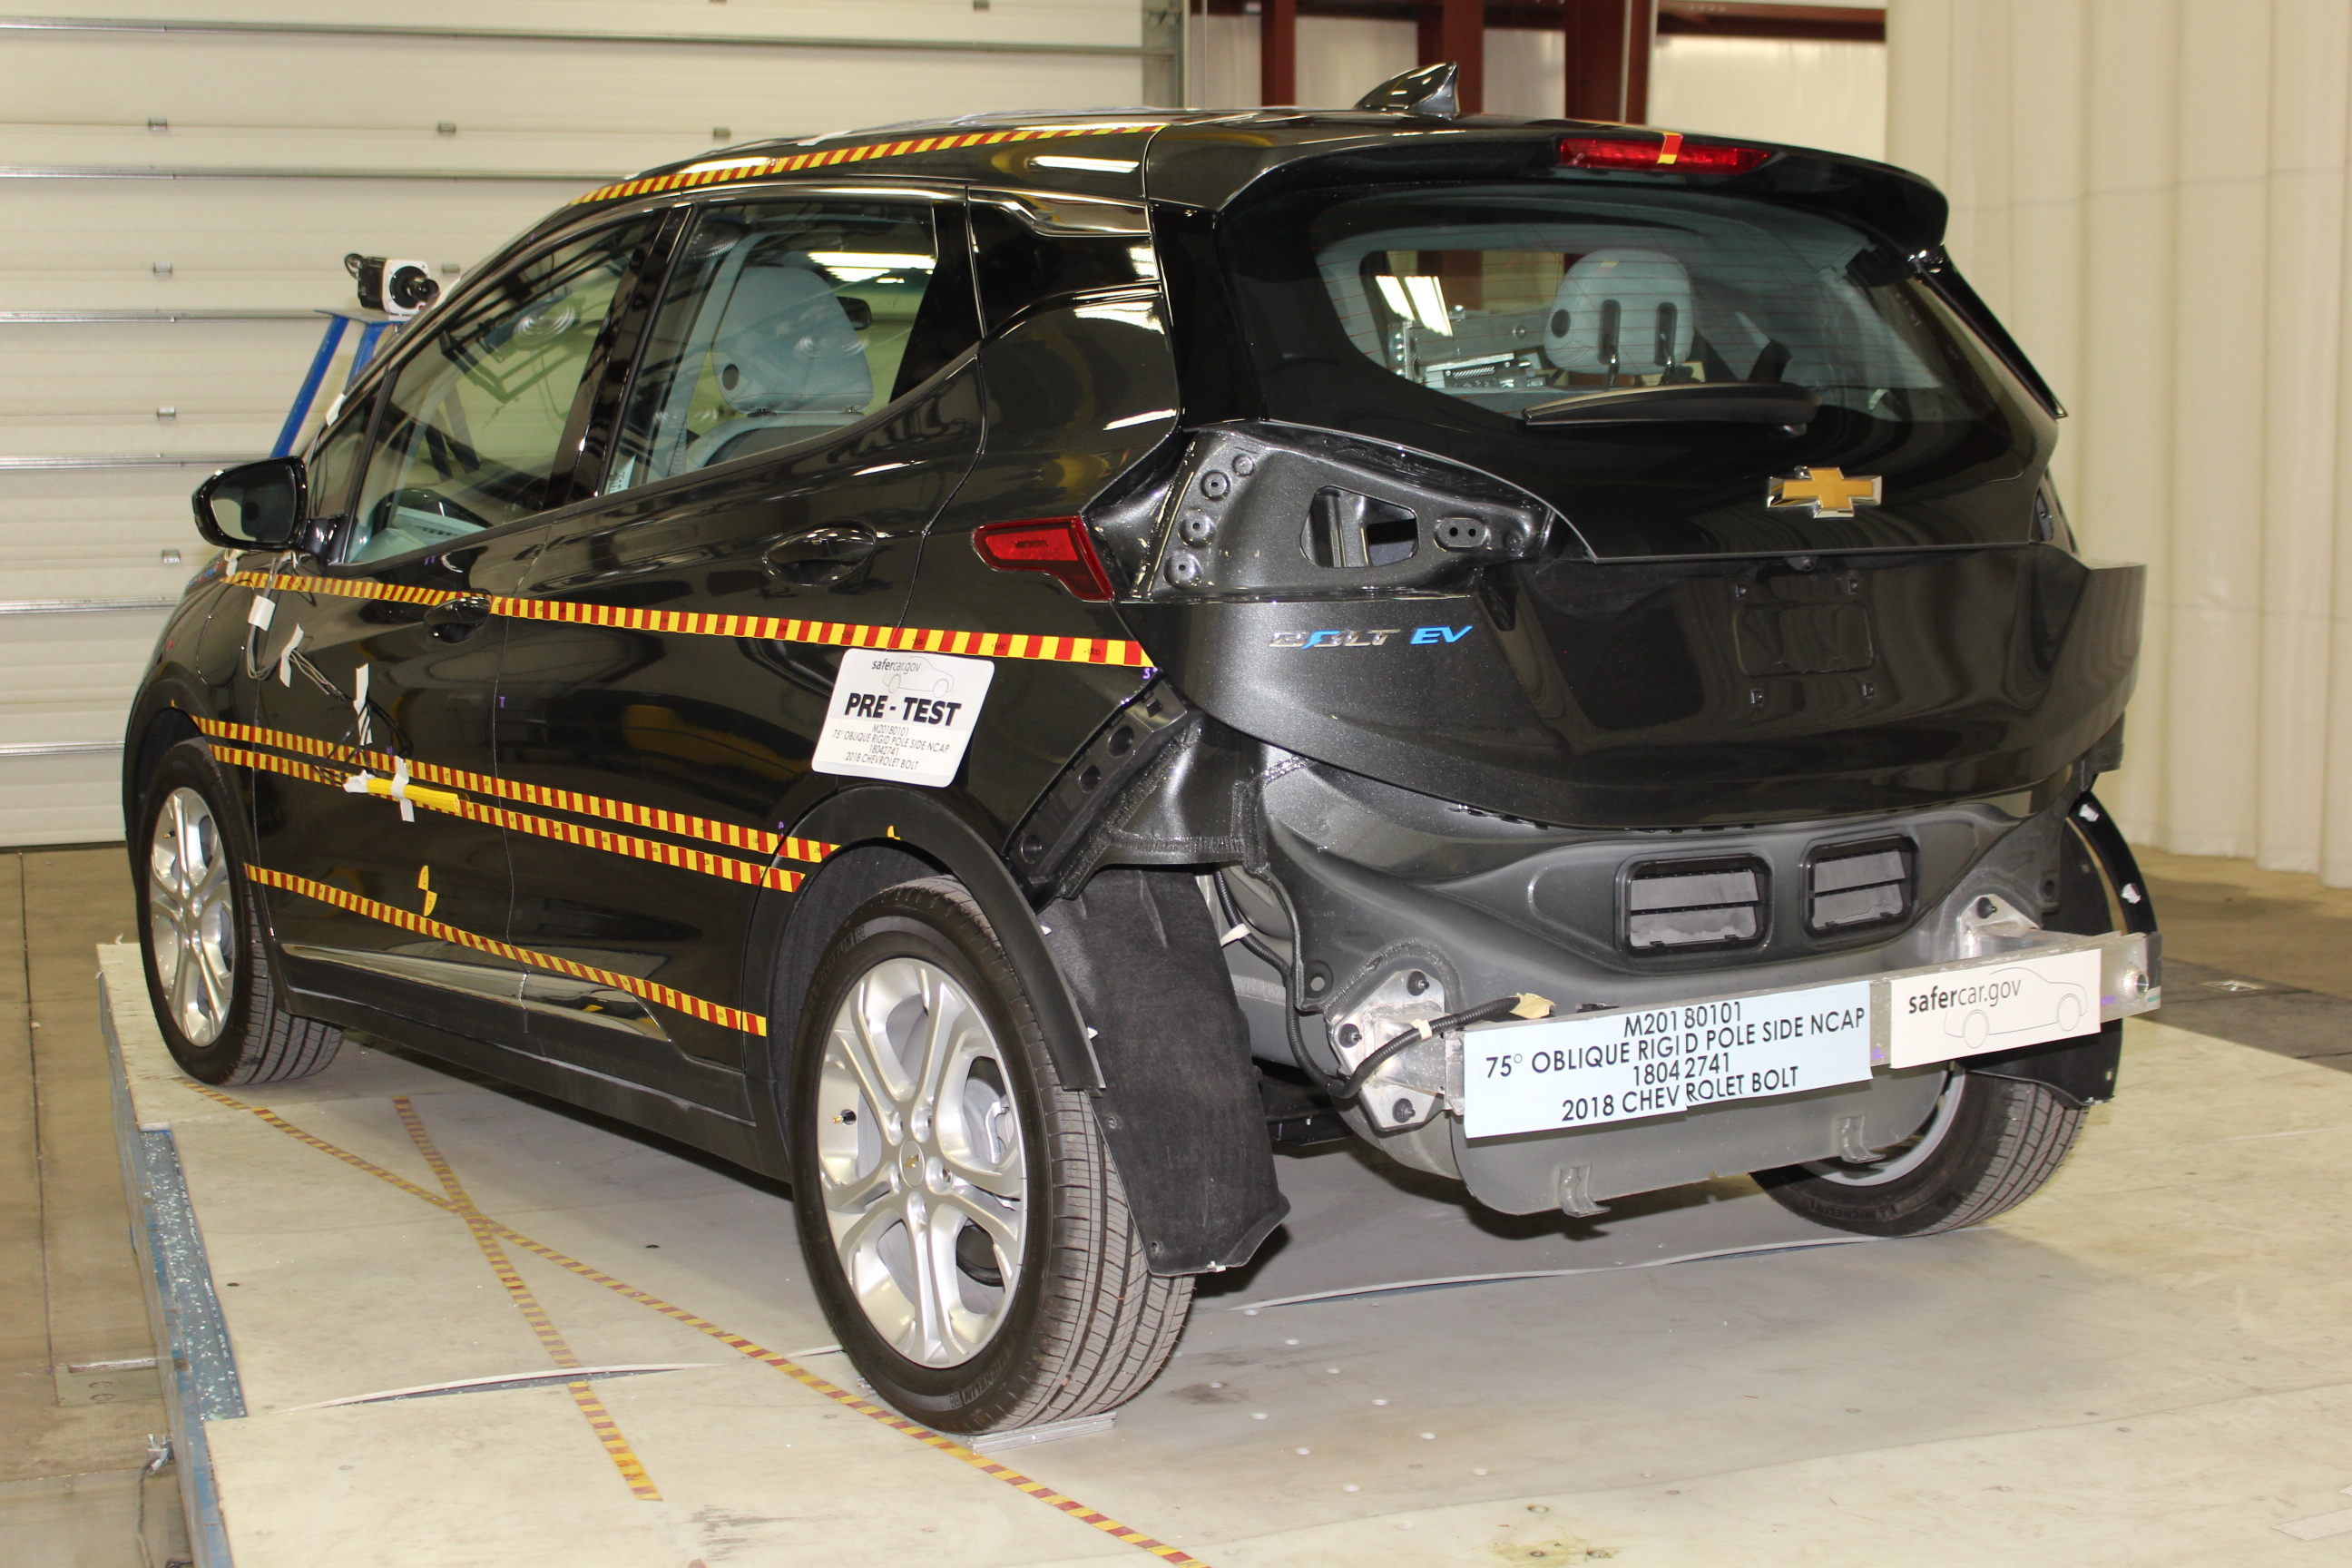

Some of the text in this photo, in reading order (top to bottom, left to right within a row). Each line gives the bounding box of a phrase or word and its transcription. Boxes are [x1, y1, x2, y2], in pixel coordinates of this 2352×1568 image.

[1269, 625, 1474, 650] BOLT EV
[871, 658, 921, 674] safercar.gov
[844, 692, 888, 719] PRE
[903, 697, 963, 727] TEST
[844, 730, 872, 743] OBLIQUE
[872, 735, 890, 745] RIGID
[891, 737, 910, 748] POLE
[911, 740, 927, 750] SIDE
[927, 742, 950, 754] NCAP
[872, 724, 910, 737] M20180101
[845, 751, 919, 770] 2018 CHEVROLET BOLT
[869, 744, 898, 756] 18042741
[1908, 979, 2022, 1014] safercar.gov
[1485, 1007, 1866, 1079] 75° OBLIQUE RIGID POLE SIDE NCAP
[1561, 1094, 1615, 1122] 2018
[1751, 1066, 1798, 1093] BOLT
